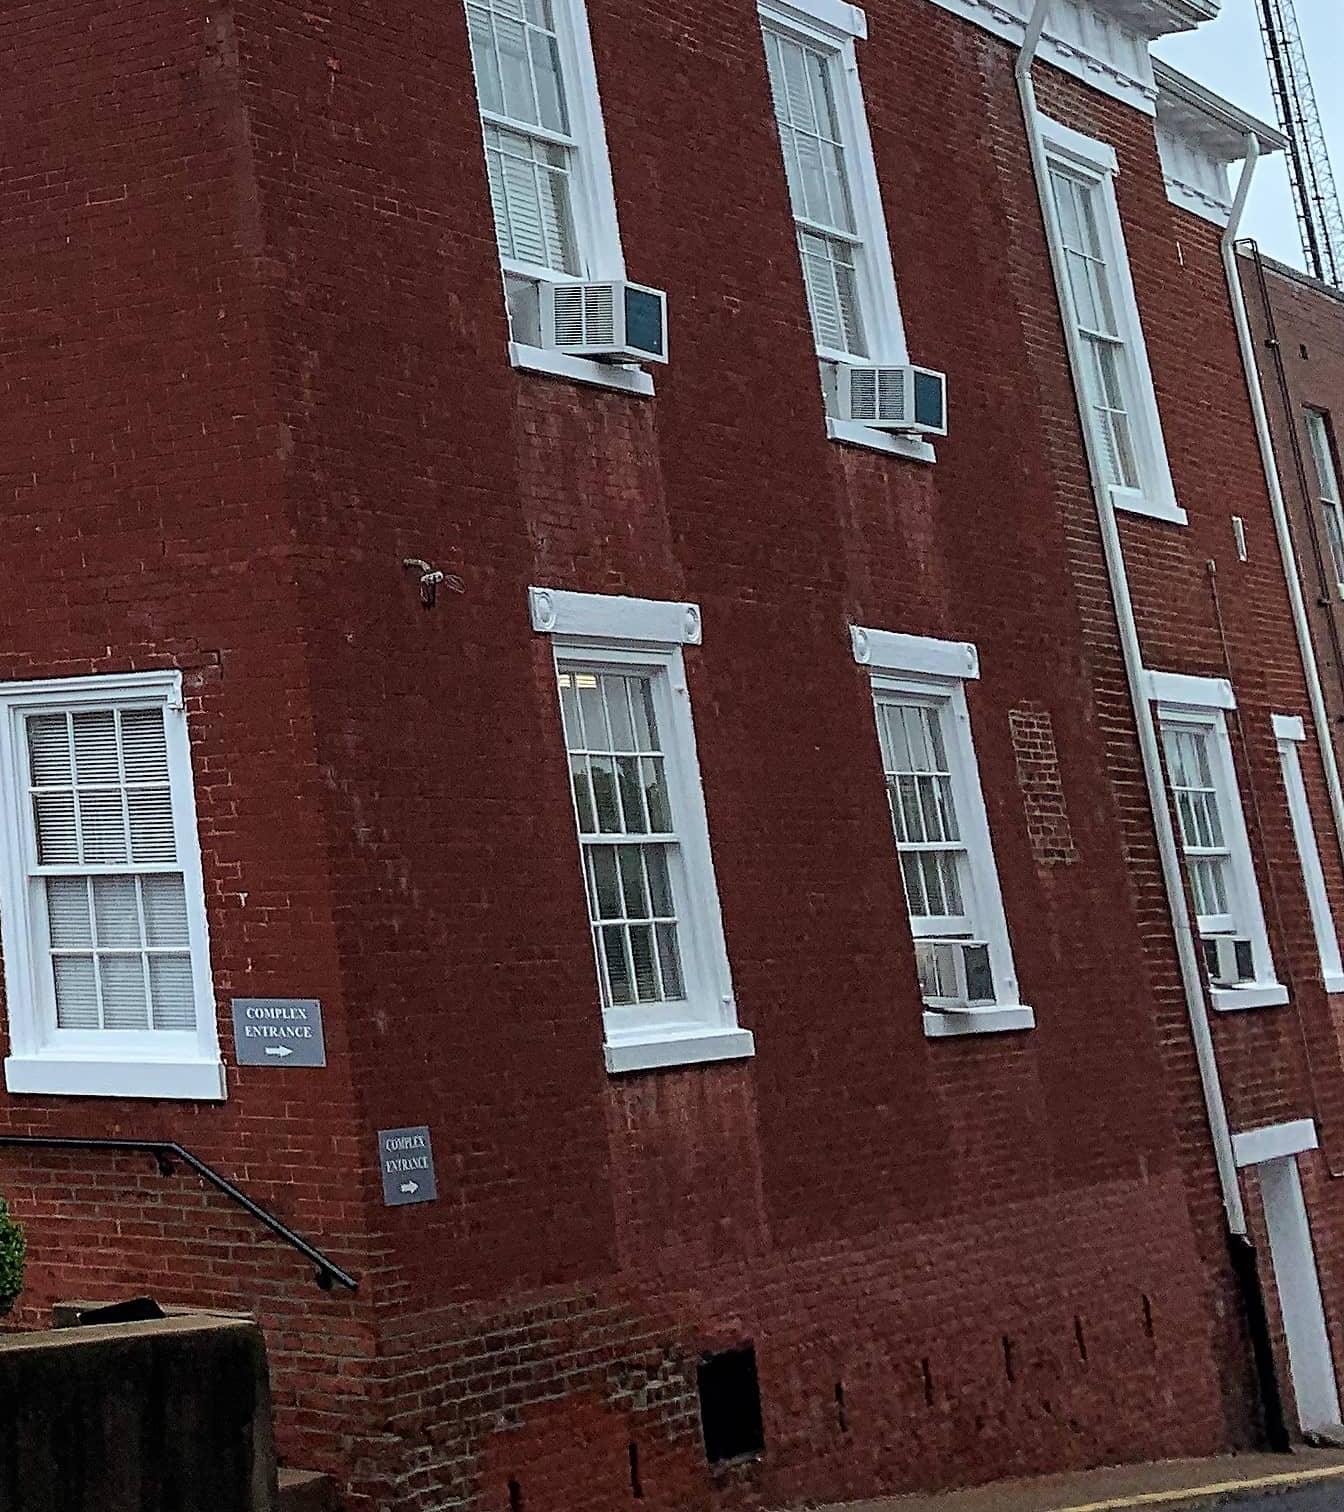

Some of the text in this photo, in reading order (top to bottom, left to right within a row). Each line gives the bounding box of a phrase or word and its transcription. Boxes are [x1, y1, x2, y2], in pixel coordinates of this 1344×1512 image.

[246, 1007, 307, 1019] COMPLEX
[244, 1025, 312, 1038] ENTRANCE
[385, 1135, 425, 1152] COMPLEX
[385, 1156, 429, 1173] ENTRANCE
